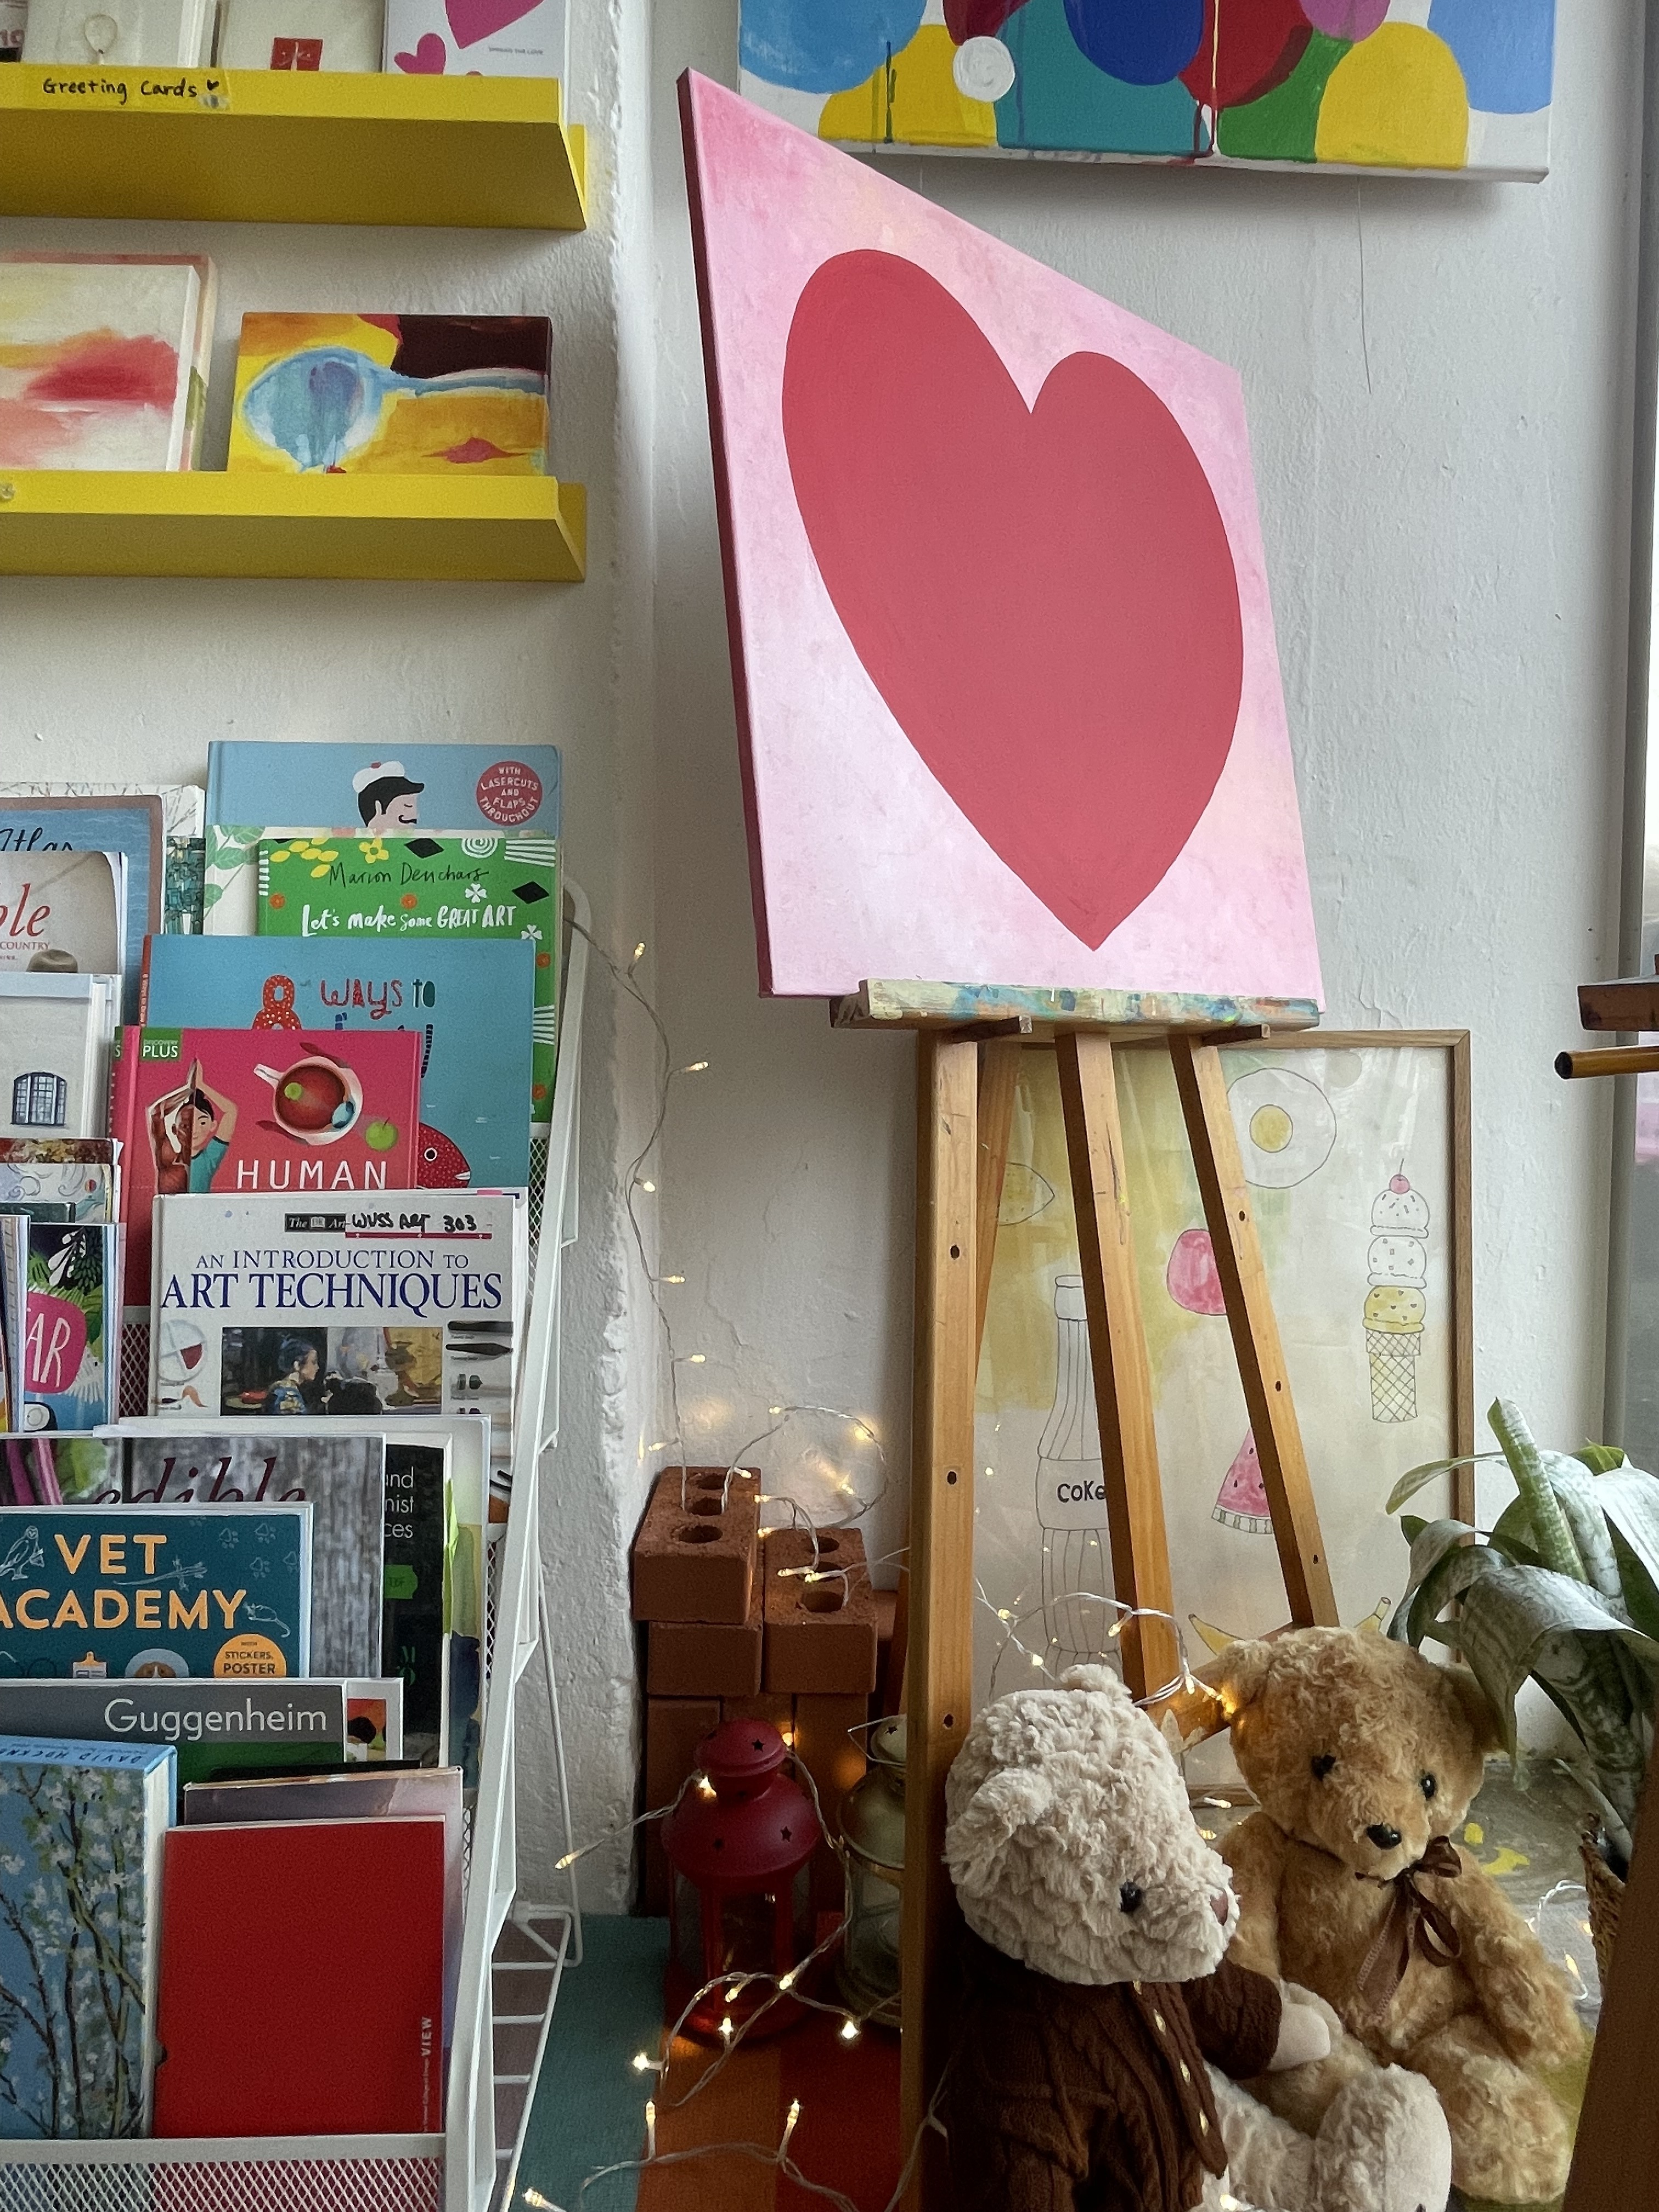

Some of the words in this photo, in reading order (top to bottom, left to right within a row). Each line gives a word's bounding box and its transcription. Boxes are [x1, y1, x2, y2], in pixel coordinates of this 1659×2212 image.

[43, 78, 127, 105] Greeting
[140, 77, 197, 97] Cards
[499, 766, 521, 775] WITH
[481, 777, 539, 791] LASERCUTS
[479, 795, 538, 822] THROUGHOUT
[493, 797, 526, 809] FLAPS
[330, 862, 391, 888] Marion
[302, 904, 340, 937] Let's
[348, 905, 396, 932] make
[437, 905, 480, 929] GREAT
[482, 905, 517, 928] ART
[0, 941, 50, 950] COUNTRY
[143, 1046, 179, 1058] PLUS
[237, 1160, 386, 1189] HUMAN
[289, 1217, 307, 1228] The
[443, 1215, 477, 1232] 303
[196, 1254, 224, 1268] AN
[233, 1250, 435, 1268] INTRODUCTION
[443, 1254, 469, 1268] TO
[160, 1273, 239, 1308] ART
[249, 1272, 501, 1318] TECHNIQUES
[26, 1308, 71, 1388] AR
[54, 1534, 167, 1575] VET
[224, 1663, 275, 1674] POSTER
[104, 1698, 327, 1741] Guggenheim
[78, 1752, 142, 1764] DAVID
[421, 2017, 432, 2056] VIEW
